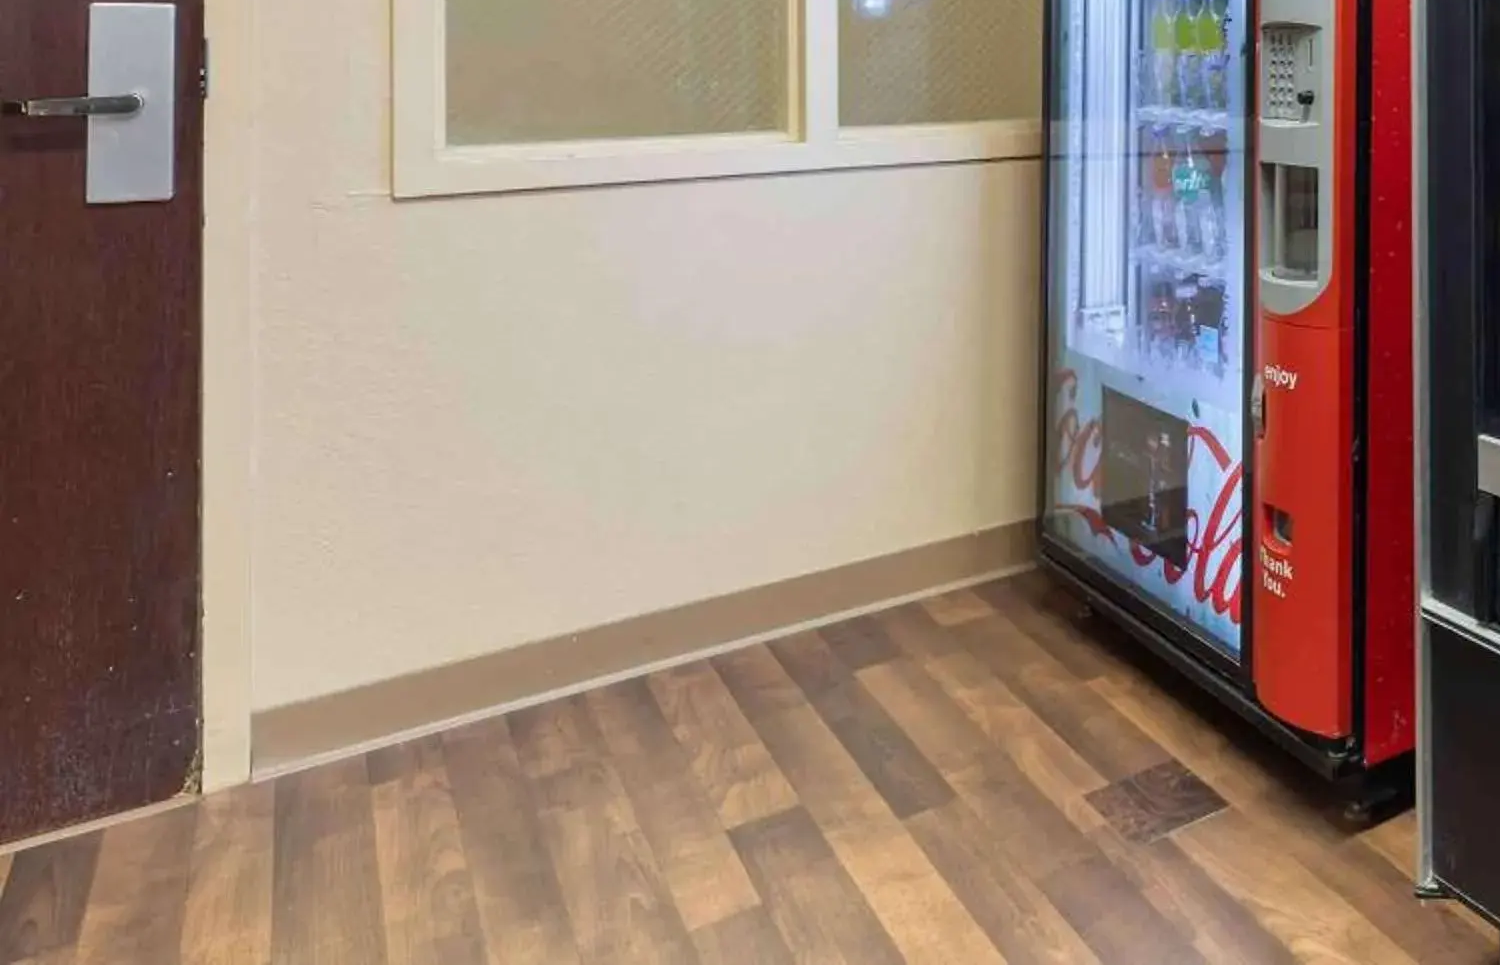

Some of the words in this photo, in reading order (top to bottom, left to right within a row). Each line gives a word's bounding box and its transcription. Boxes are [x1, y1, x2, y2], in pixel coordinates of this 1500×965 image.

[1264, 364, 1298, 390] enjoy
[1260, 545, 1294, 580] Thank
[1263, 570, 1287, 599] You.
